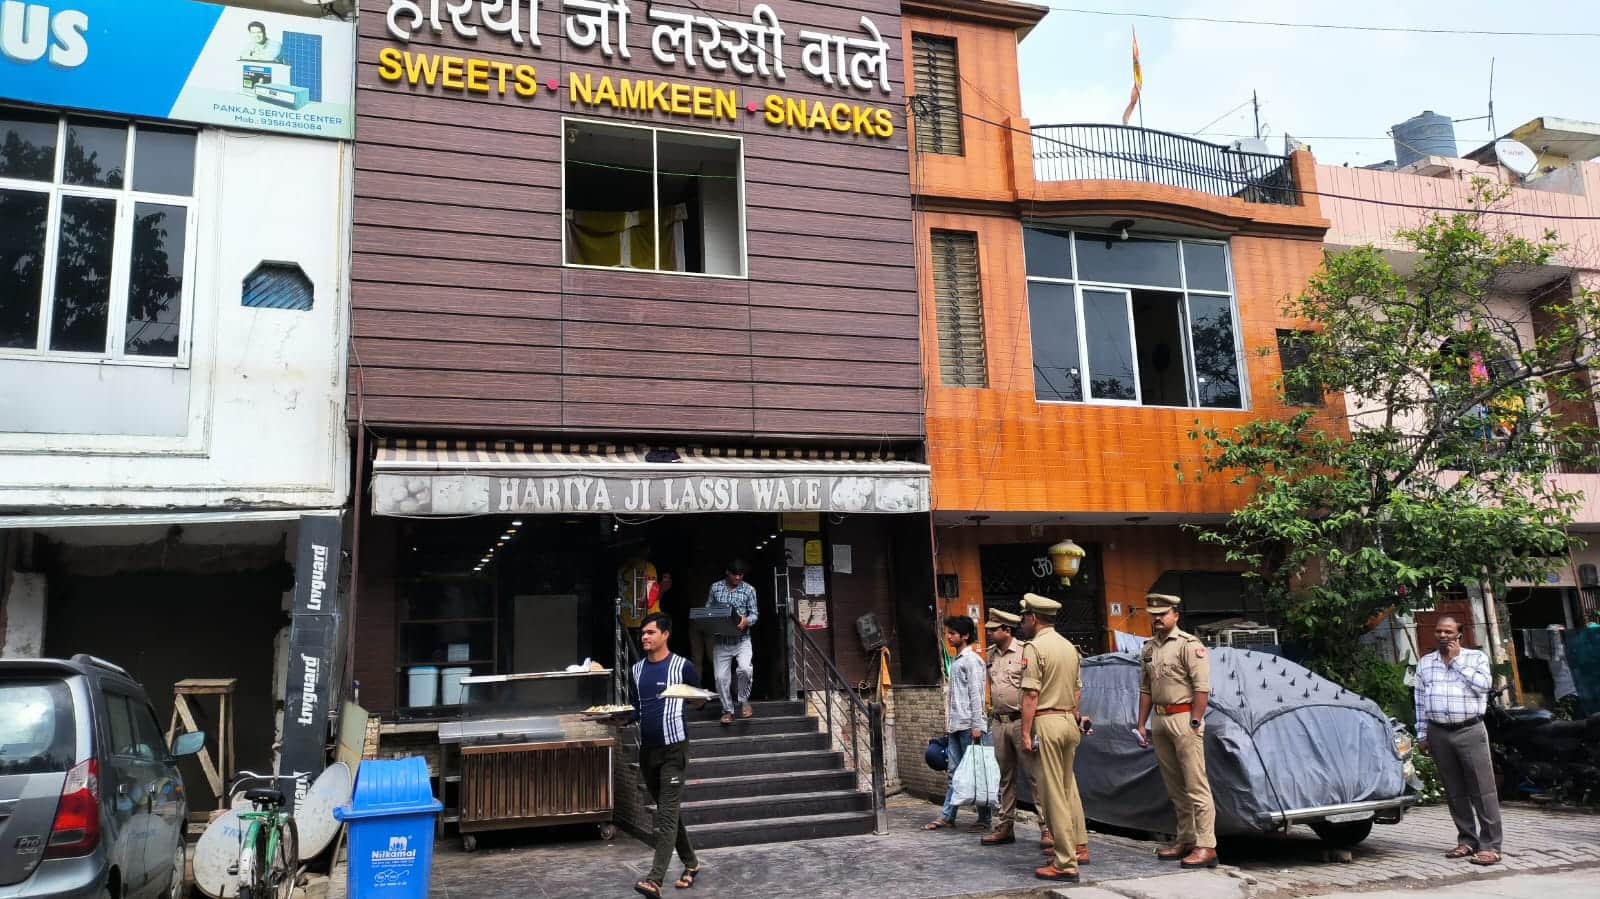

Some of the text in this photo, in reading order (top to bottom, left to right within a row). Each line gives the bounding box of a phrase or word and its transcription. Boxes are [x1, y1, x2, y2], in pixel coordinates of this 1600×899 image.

[649, 3, 786, 80] लस्सी
[799, 15, 893, 93] वाले
[213, 103, 342, 125] PANKAJ SERVICE CENTER
[377, 47, 895, 138] SWEETS NAMKEEN SNACKS
[498, 478, 821, 511] HARIYA JI LASSI WALE
[306, 543, 326, 611] Livguard
[297, 653, 319, 726] Livguard
[371, 848, 416, 859] Nilkamal
